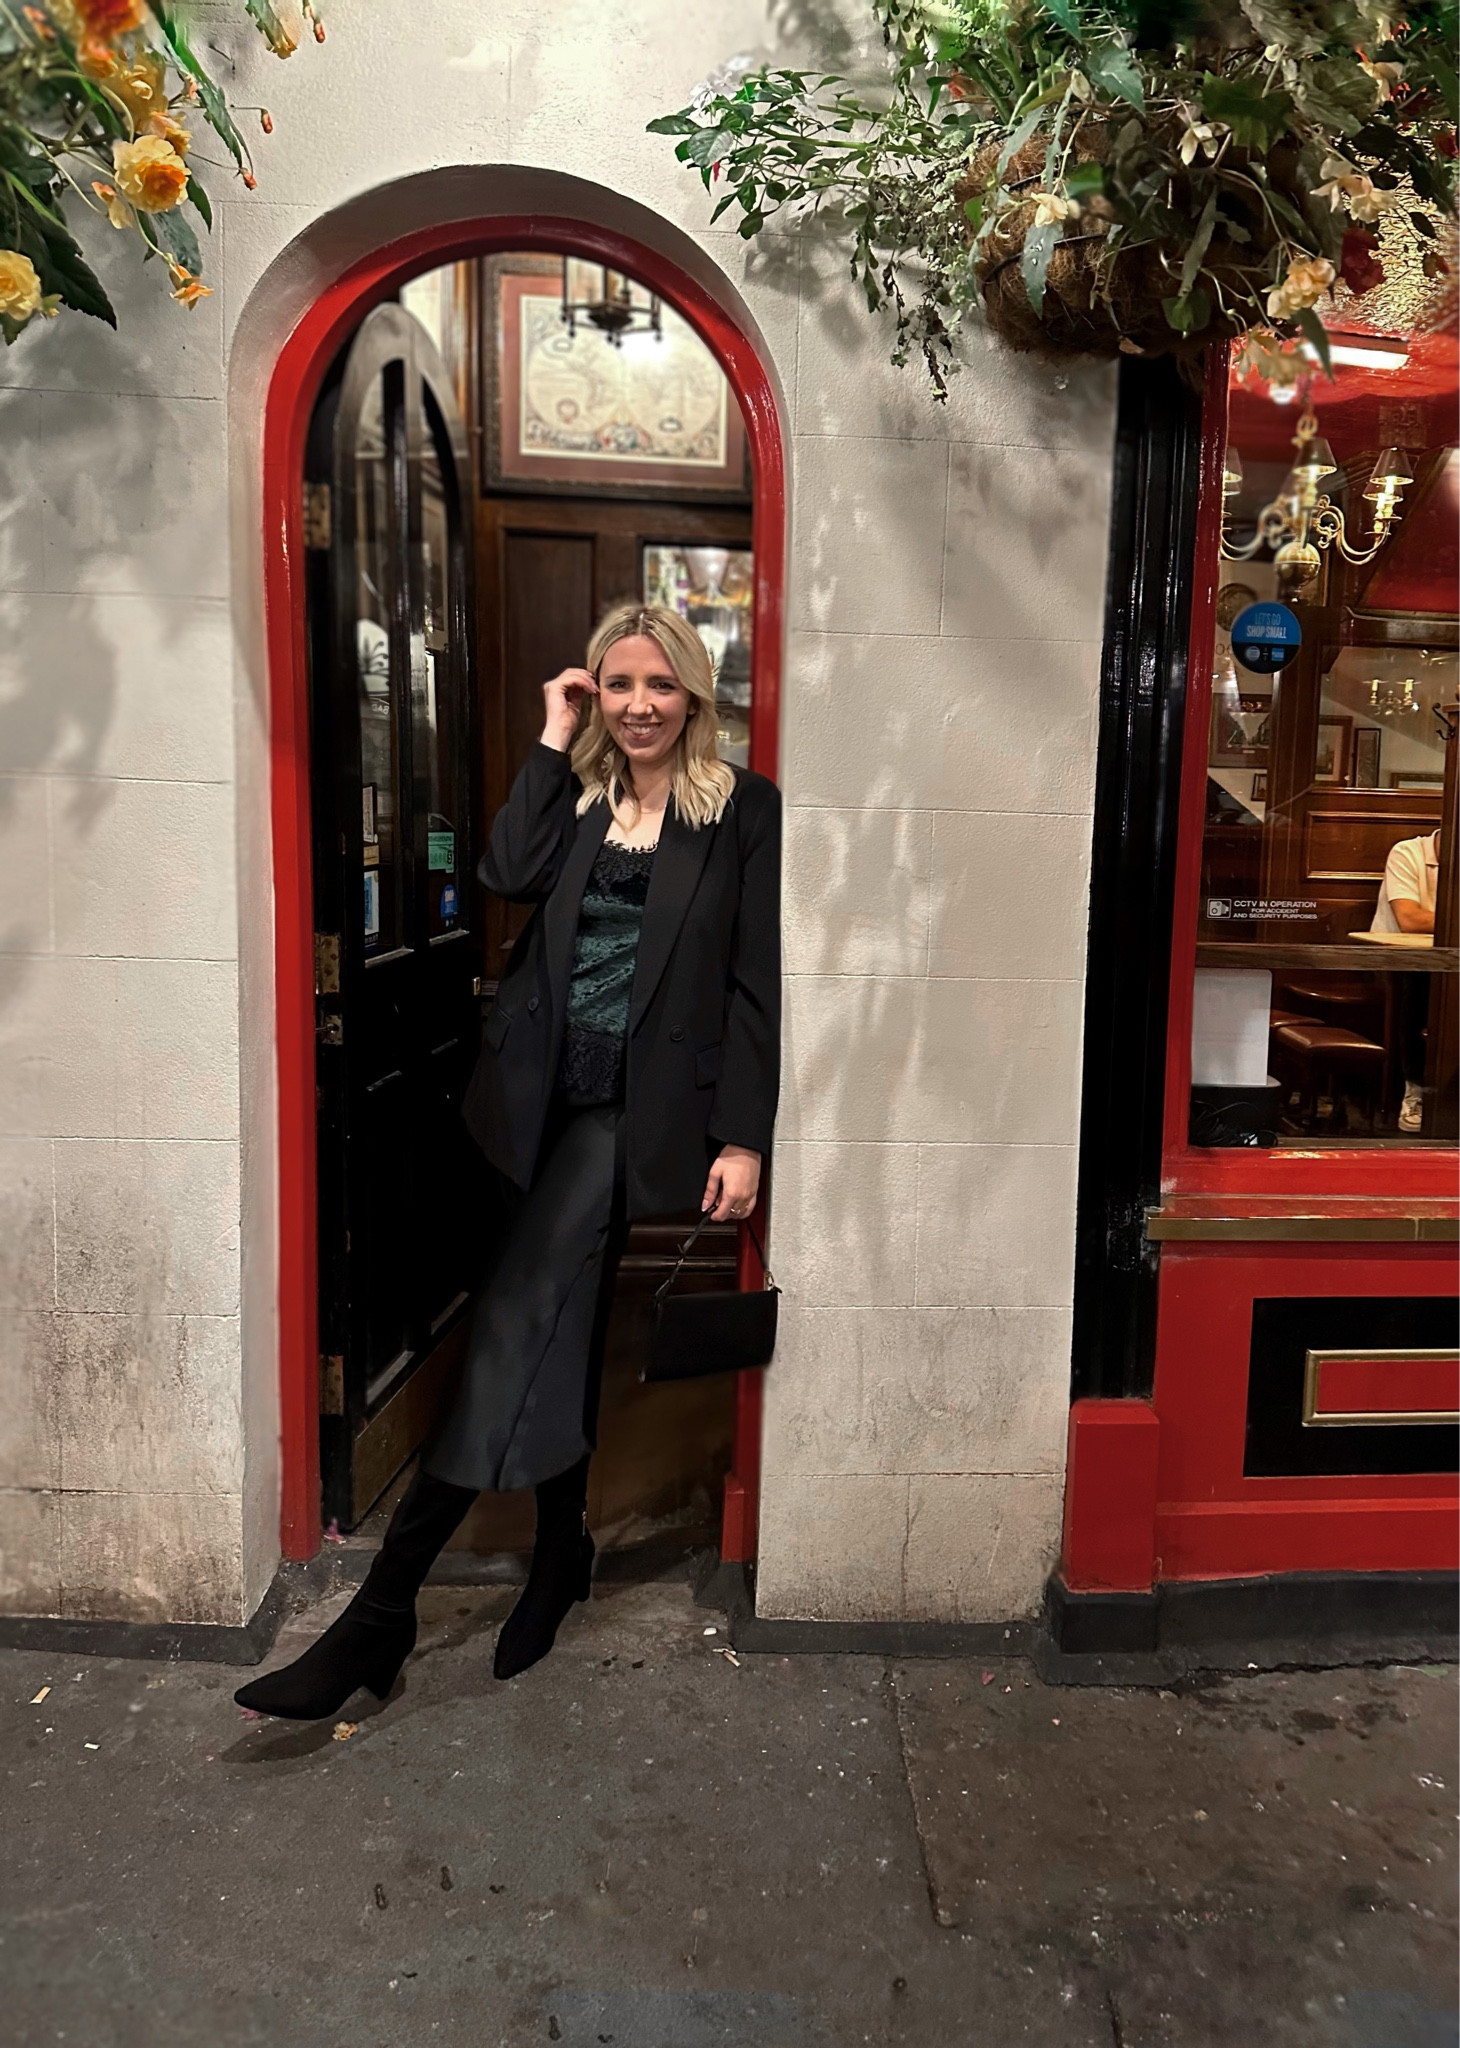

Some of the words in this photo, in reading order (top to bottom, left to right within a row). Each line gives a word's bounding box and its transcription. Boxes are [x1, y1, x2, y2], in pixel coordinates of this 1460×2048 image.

[1272, 613, 1281, 626] GO
[1247, 625, 1265, 638] SHOP
[1266, 626, 1287, 639] SMALL
